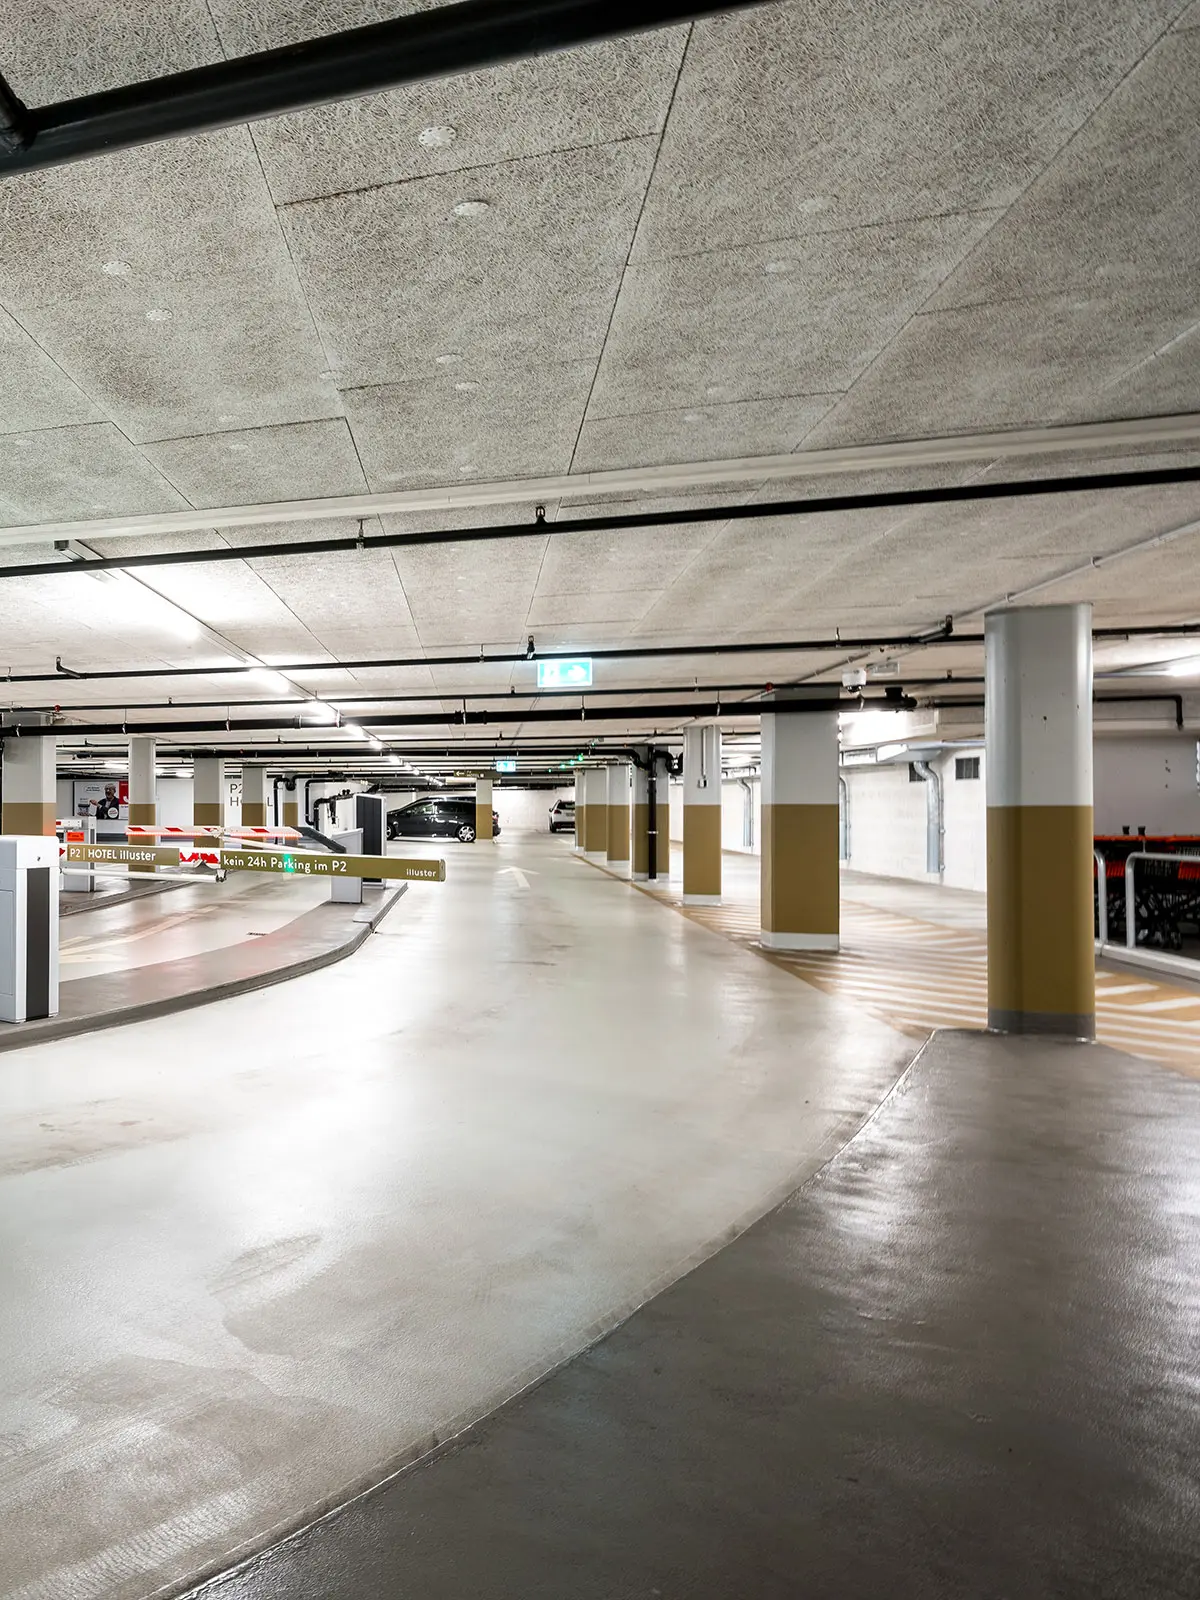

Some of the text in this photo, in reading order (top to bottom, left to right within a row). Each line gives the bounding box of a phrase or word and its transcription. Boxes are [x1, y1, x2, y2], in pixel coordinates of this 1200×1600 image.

[70, 848, 156, 861] P2 HOTEL illuster
[223, 855, 347, 874] kein 24h Parking im P2
[406, 868, 437, 877] illuster
